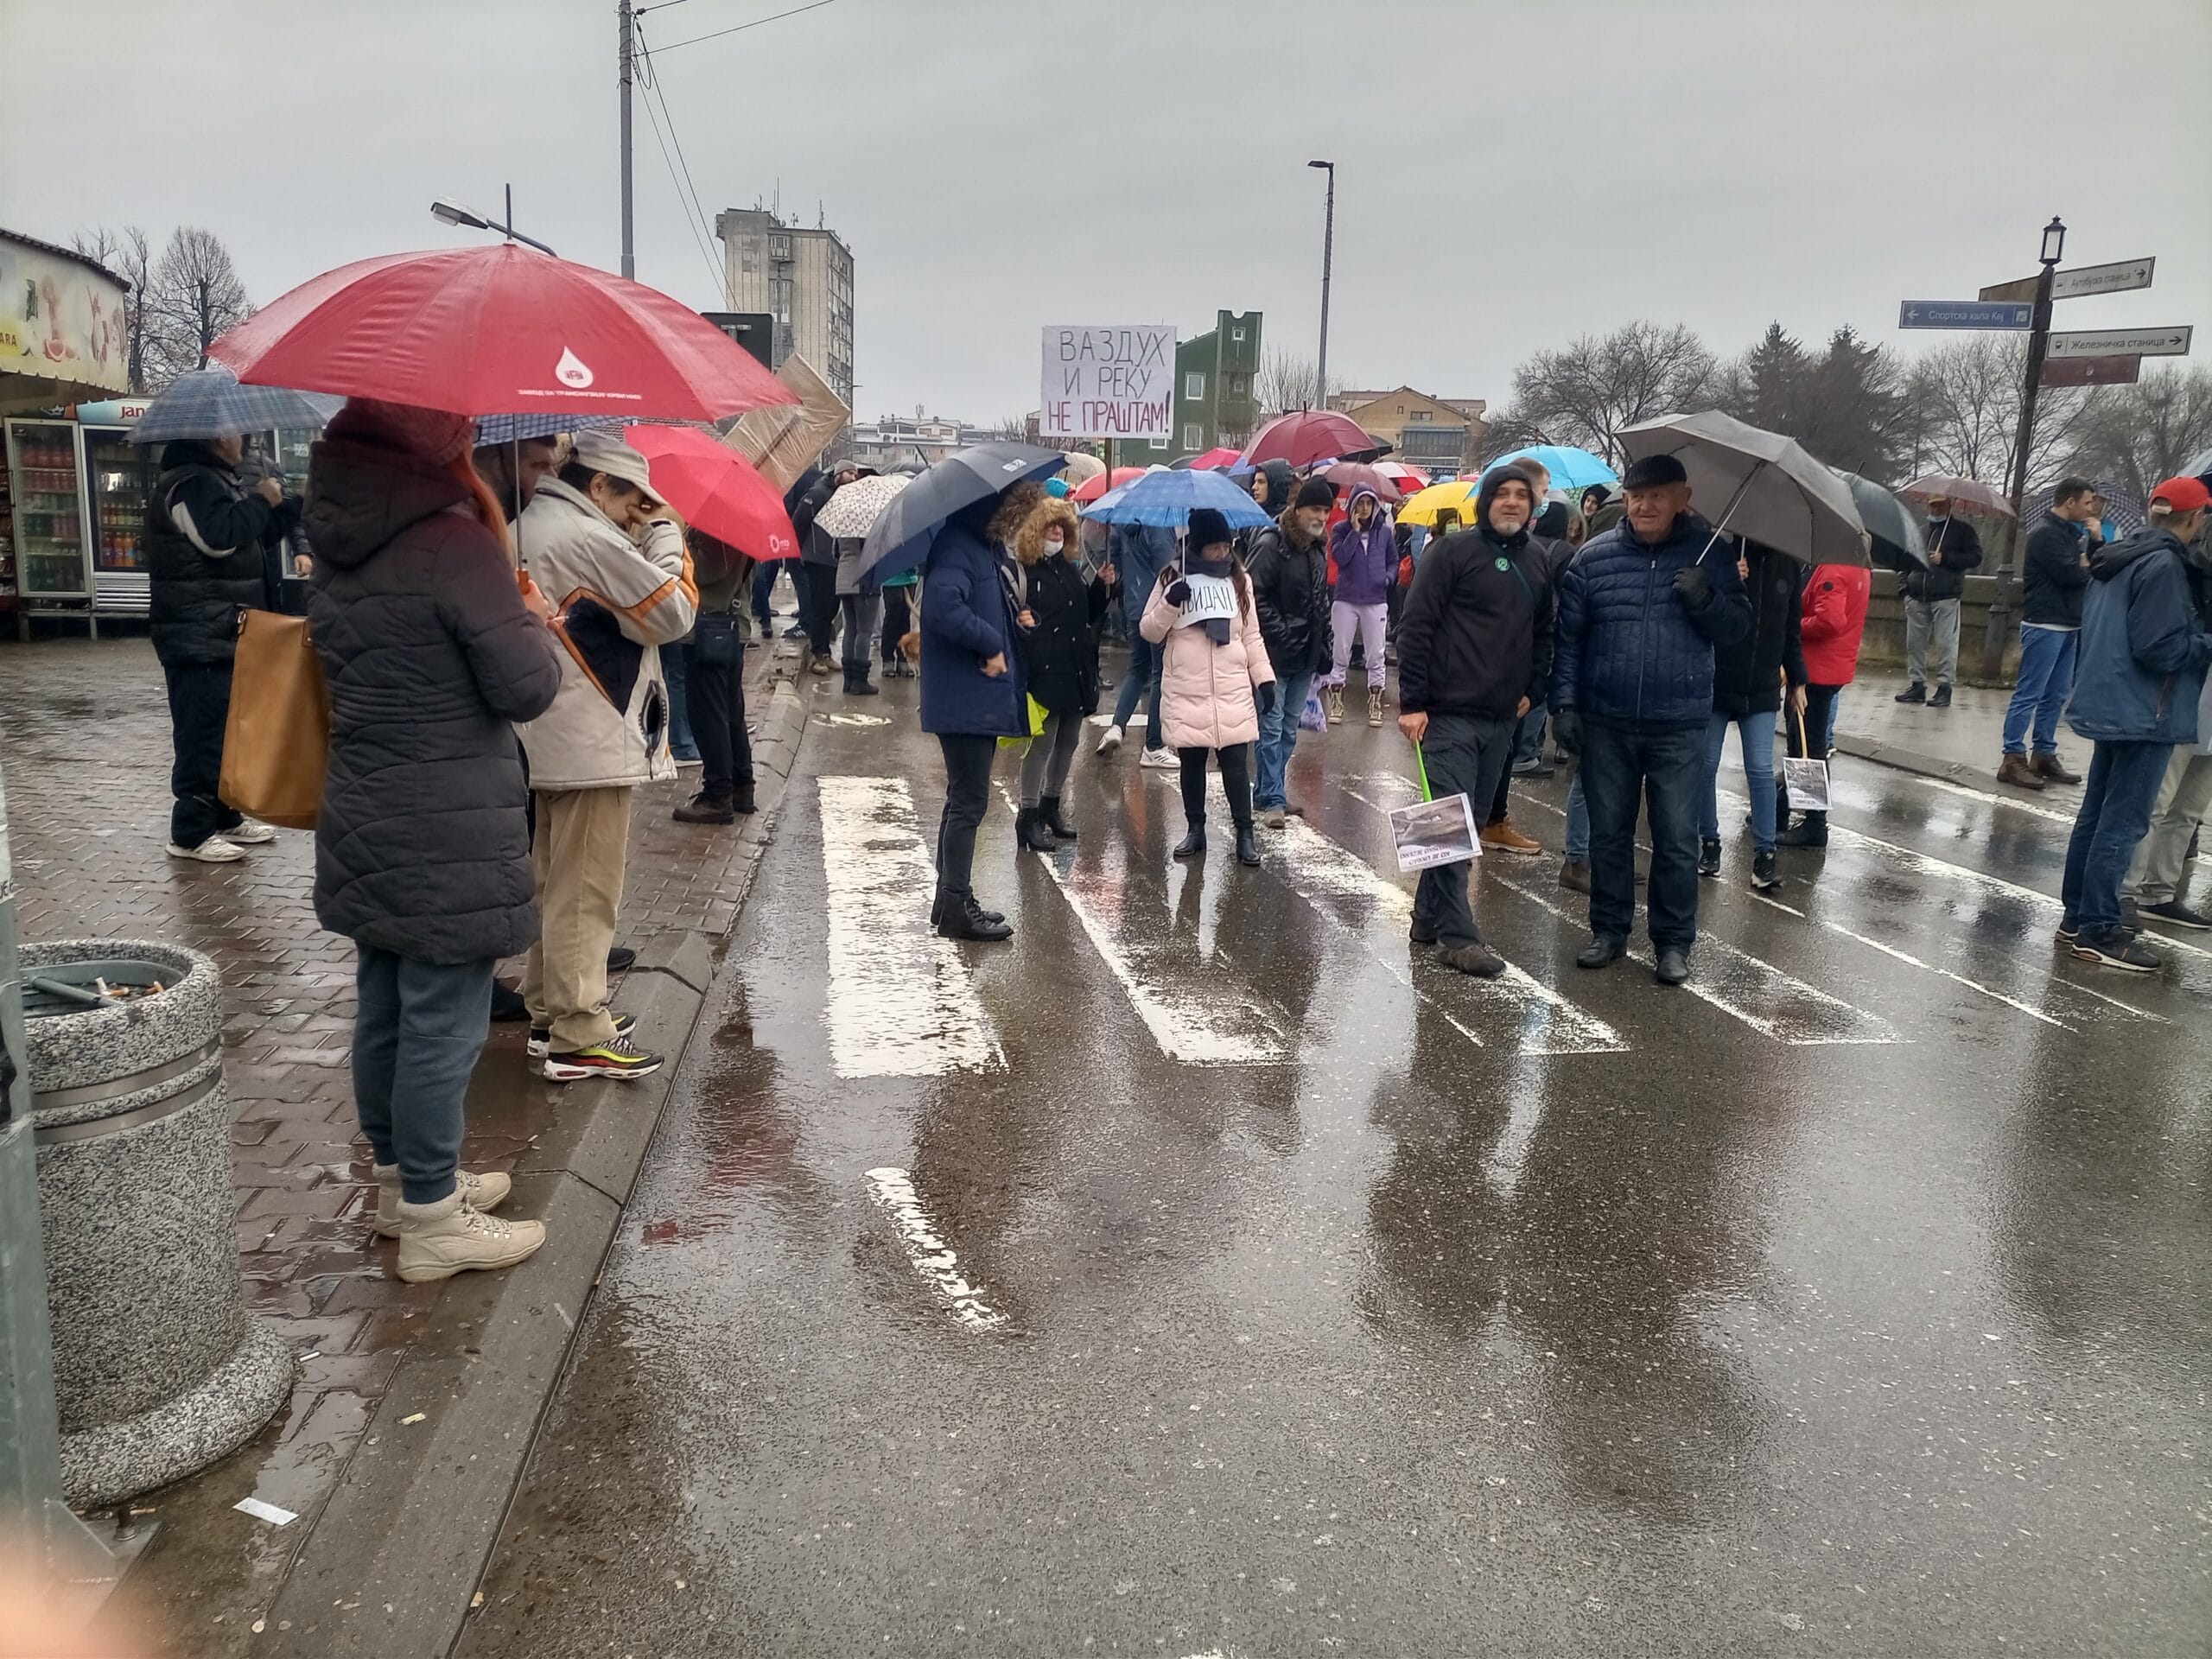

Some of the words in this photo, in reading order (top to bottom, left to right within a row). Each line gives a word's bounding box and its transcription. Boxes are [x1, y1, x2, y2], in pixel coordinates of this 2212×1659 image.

[1928, 310, 1967, 321] Спортска
[1969, 312, 1990, 321] хала
[1991, 310, 2005, 323] Кеј
[1059, 329, 1168, 367] ВАЗДУХ
[2070, 340, 2126, 351] Железничка
[2127, 338, 2165, 349] станица
[1064, 366, 1080, 397] И
[1097, 365, 1152, 400] РЕКУ
[1048, 400, 1071, 432] НЕ
[1082, 390, 1171, 434] ПРАШТАМ!
